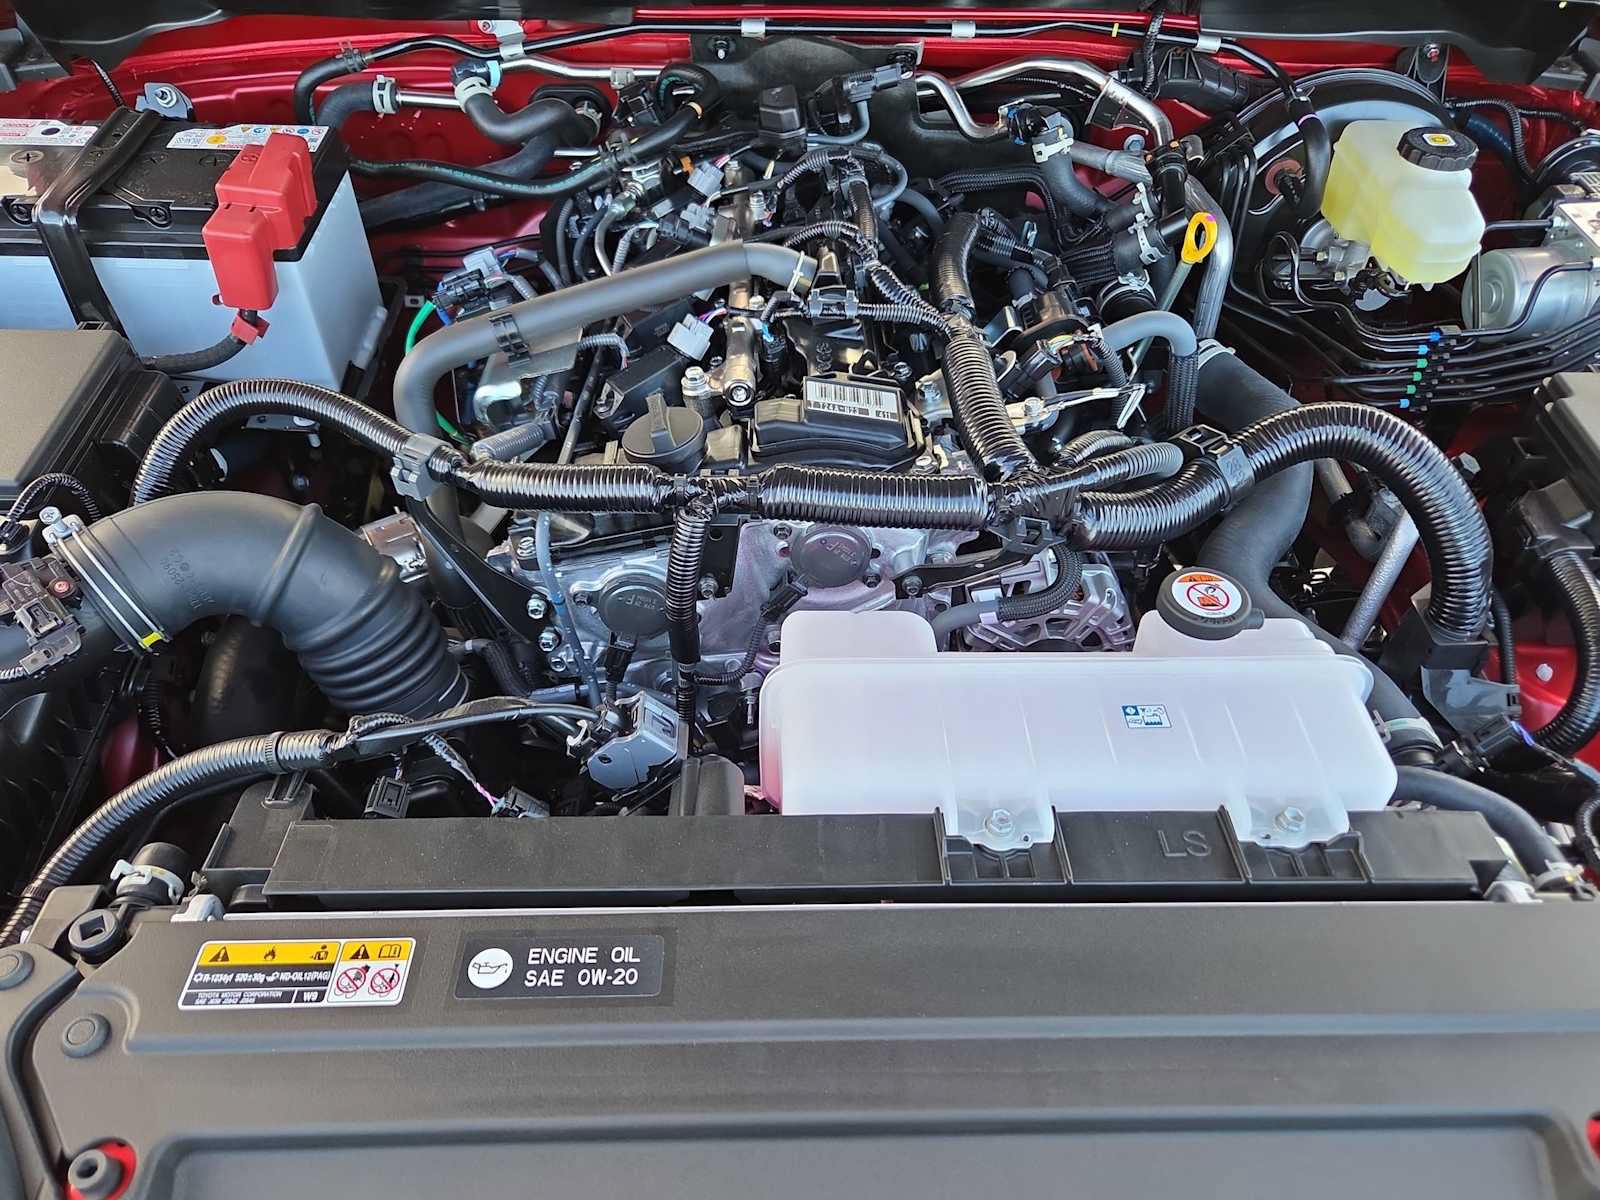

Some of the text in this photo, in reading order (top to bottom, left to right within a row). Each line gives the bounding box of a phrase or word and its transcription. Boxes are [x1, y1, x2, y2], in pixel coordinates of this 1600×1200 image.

[1157, 830, 1212, 857] LS
[527, 946, 641, 965] ENGINE OIL
[524, 967, 639, 987] SAE 0W-20
[242, 990, 283, 998] CORPORATION
